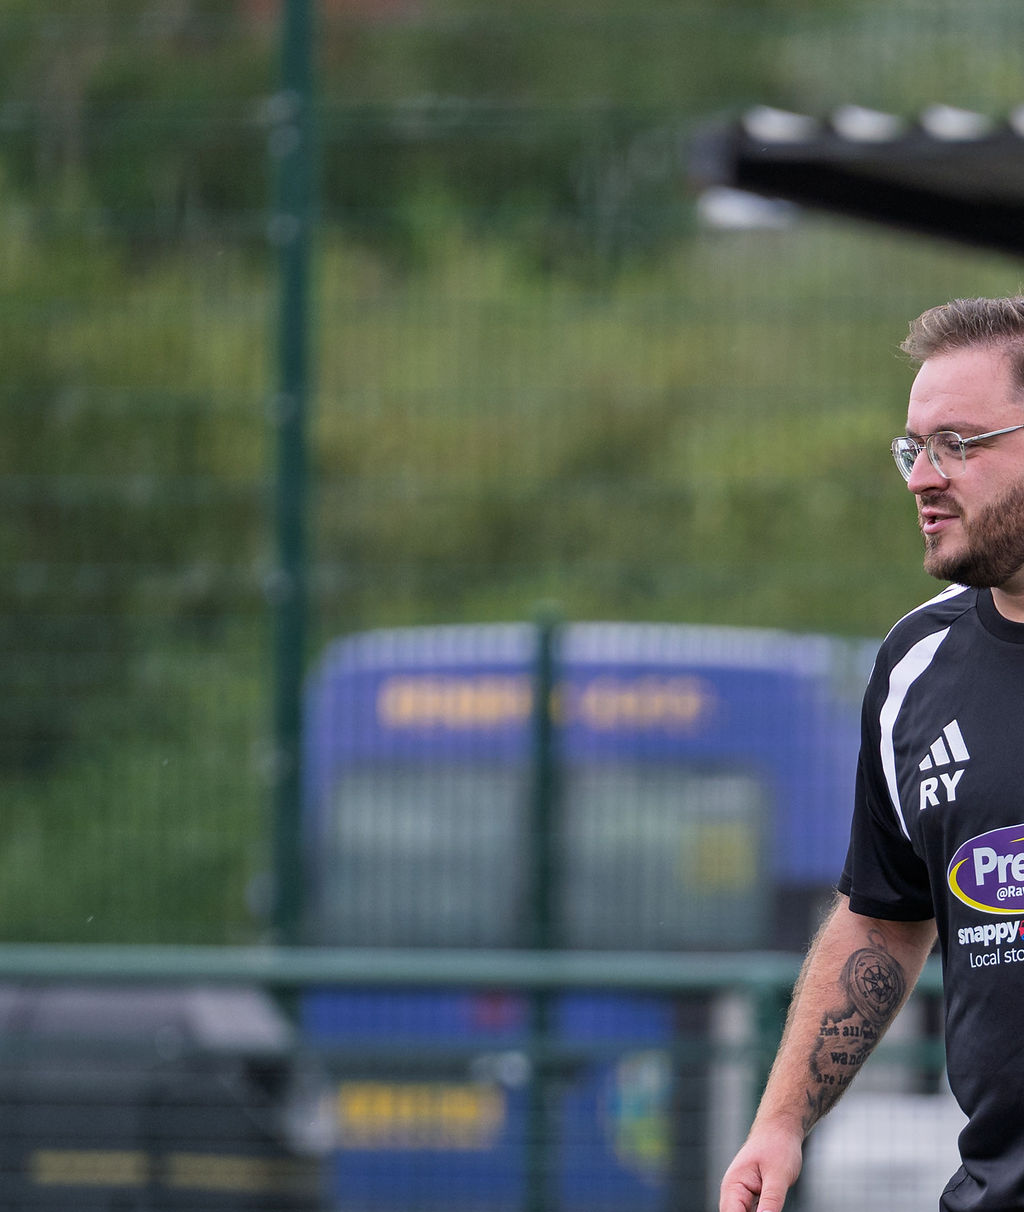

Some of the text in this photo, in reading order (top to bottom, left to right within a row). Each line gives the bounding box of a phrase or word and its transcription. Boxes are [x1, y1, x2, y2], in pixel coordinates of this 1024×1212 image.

[919, 768, 965, 810] RY
[957, 920, 1019, 946] snappy
[970, 948, 1000, 968] Local
